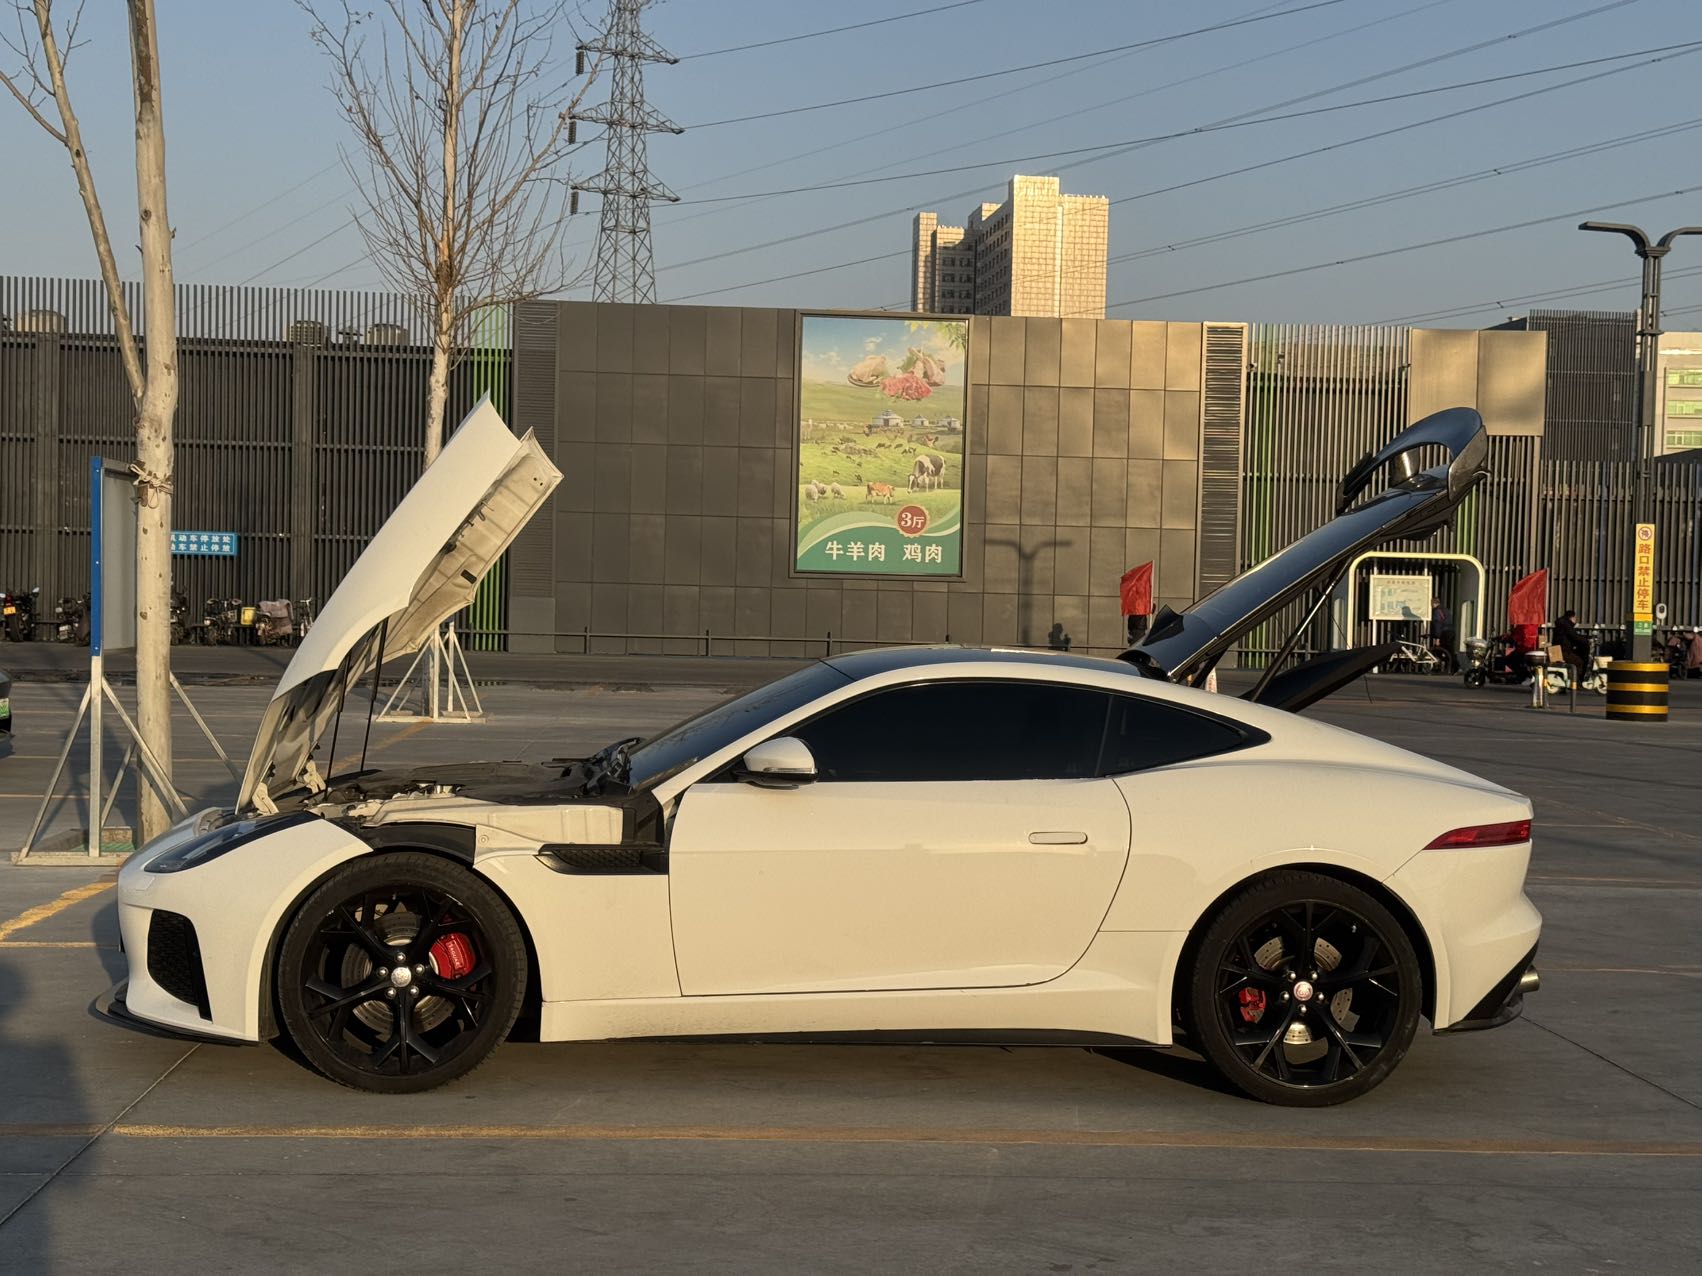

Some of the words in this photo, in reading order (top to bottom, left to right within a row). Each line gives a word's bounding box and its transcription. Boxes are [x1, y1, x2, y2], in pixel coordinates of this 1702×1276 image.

[901, 512, 925, 528] 3厅
[825, 541, 886, 561] 牛羊肉
[902, 543, 943, 563] 鸡肉
[1636, 543, 1651, 611] 路口禁止停车
